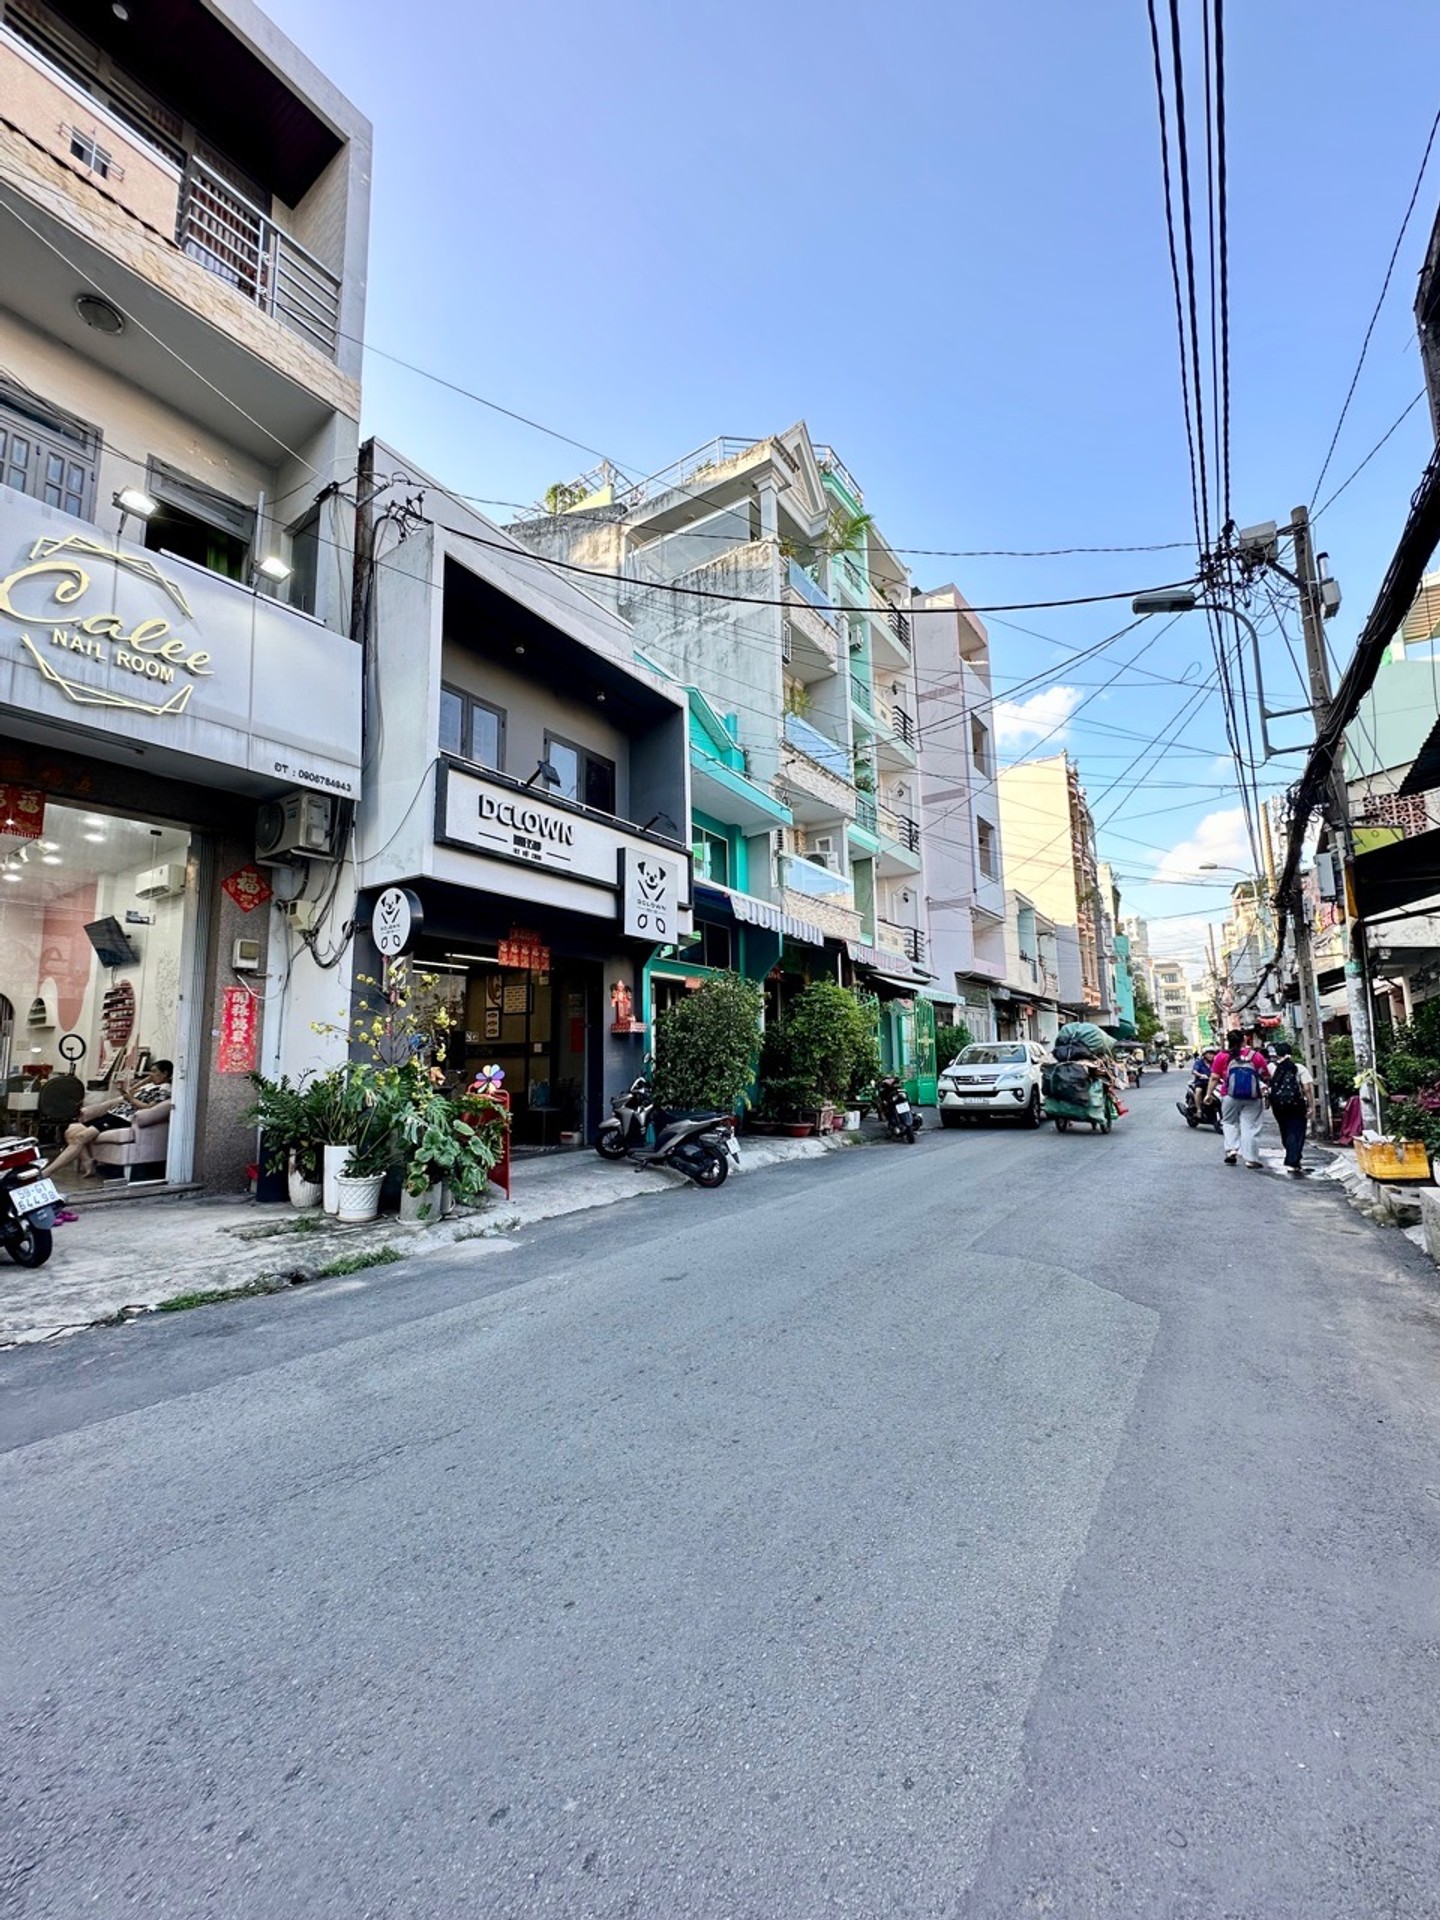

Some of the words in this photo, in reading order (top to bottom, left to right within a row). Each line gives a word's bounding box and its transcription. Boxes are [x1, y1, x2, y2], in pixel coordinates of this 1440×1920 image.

[0, 561, 214, 676] Calee
[52, 628, 107, 662] NAIL
[116, 651, 175, 683] ROOM
[479, 794, 575, 846] DCLOWN
